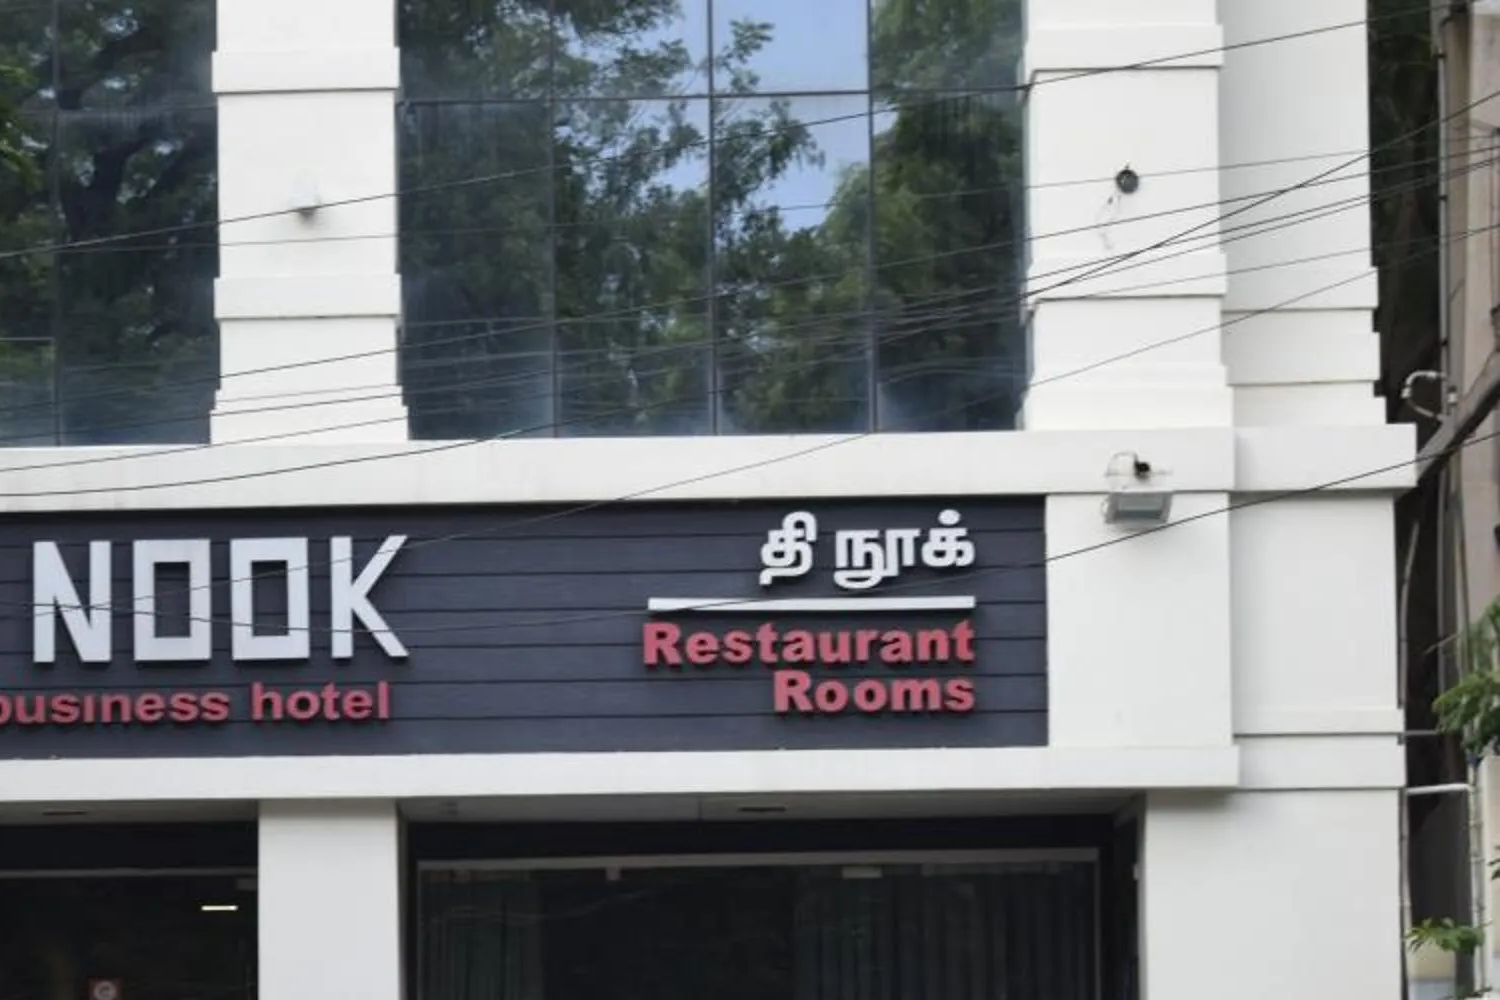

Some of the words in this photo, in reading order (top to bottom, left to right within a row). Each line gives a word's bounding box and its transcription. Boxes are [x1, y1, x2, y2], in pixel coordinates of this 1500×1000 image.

[758, 510, 818, 586] தி
[833, 509, 976, 589] நூக்
[32, 534, 410, 664] NOOK
[642, 619, 975, 666] Restaurant
[250, 681, 391, 721] hotel
[773, 668, 975, 713] Rooms
